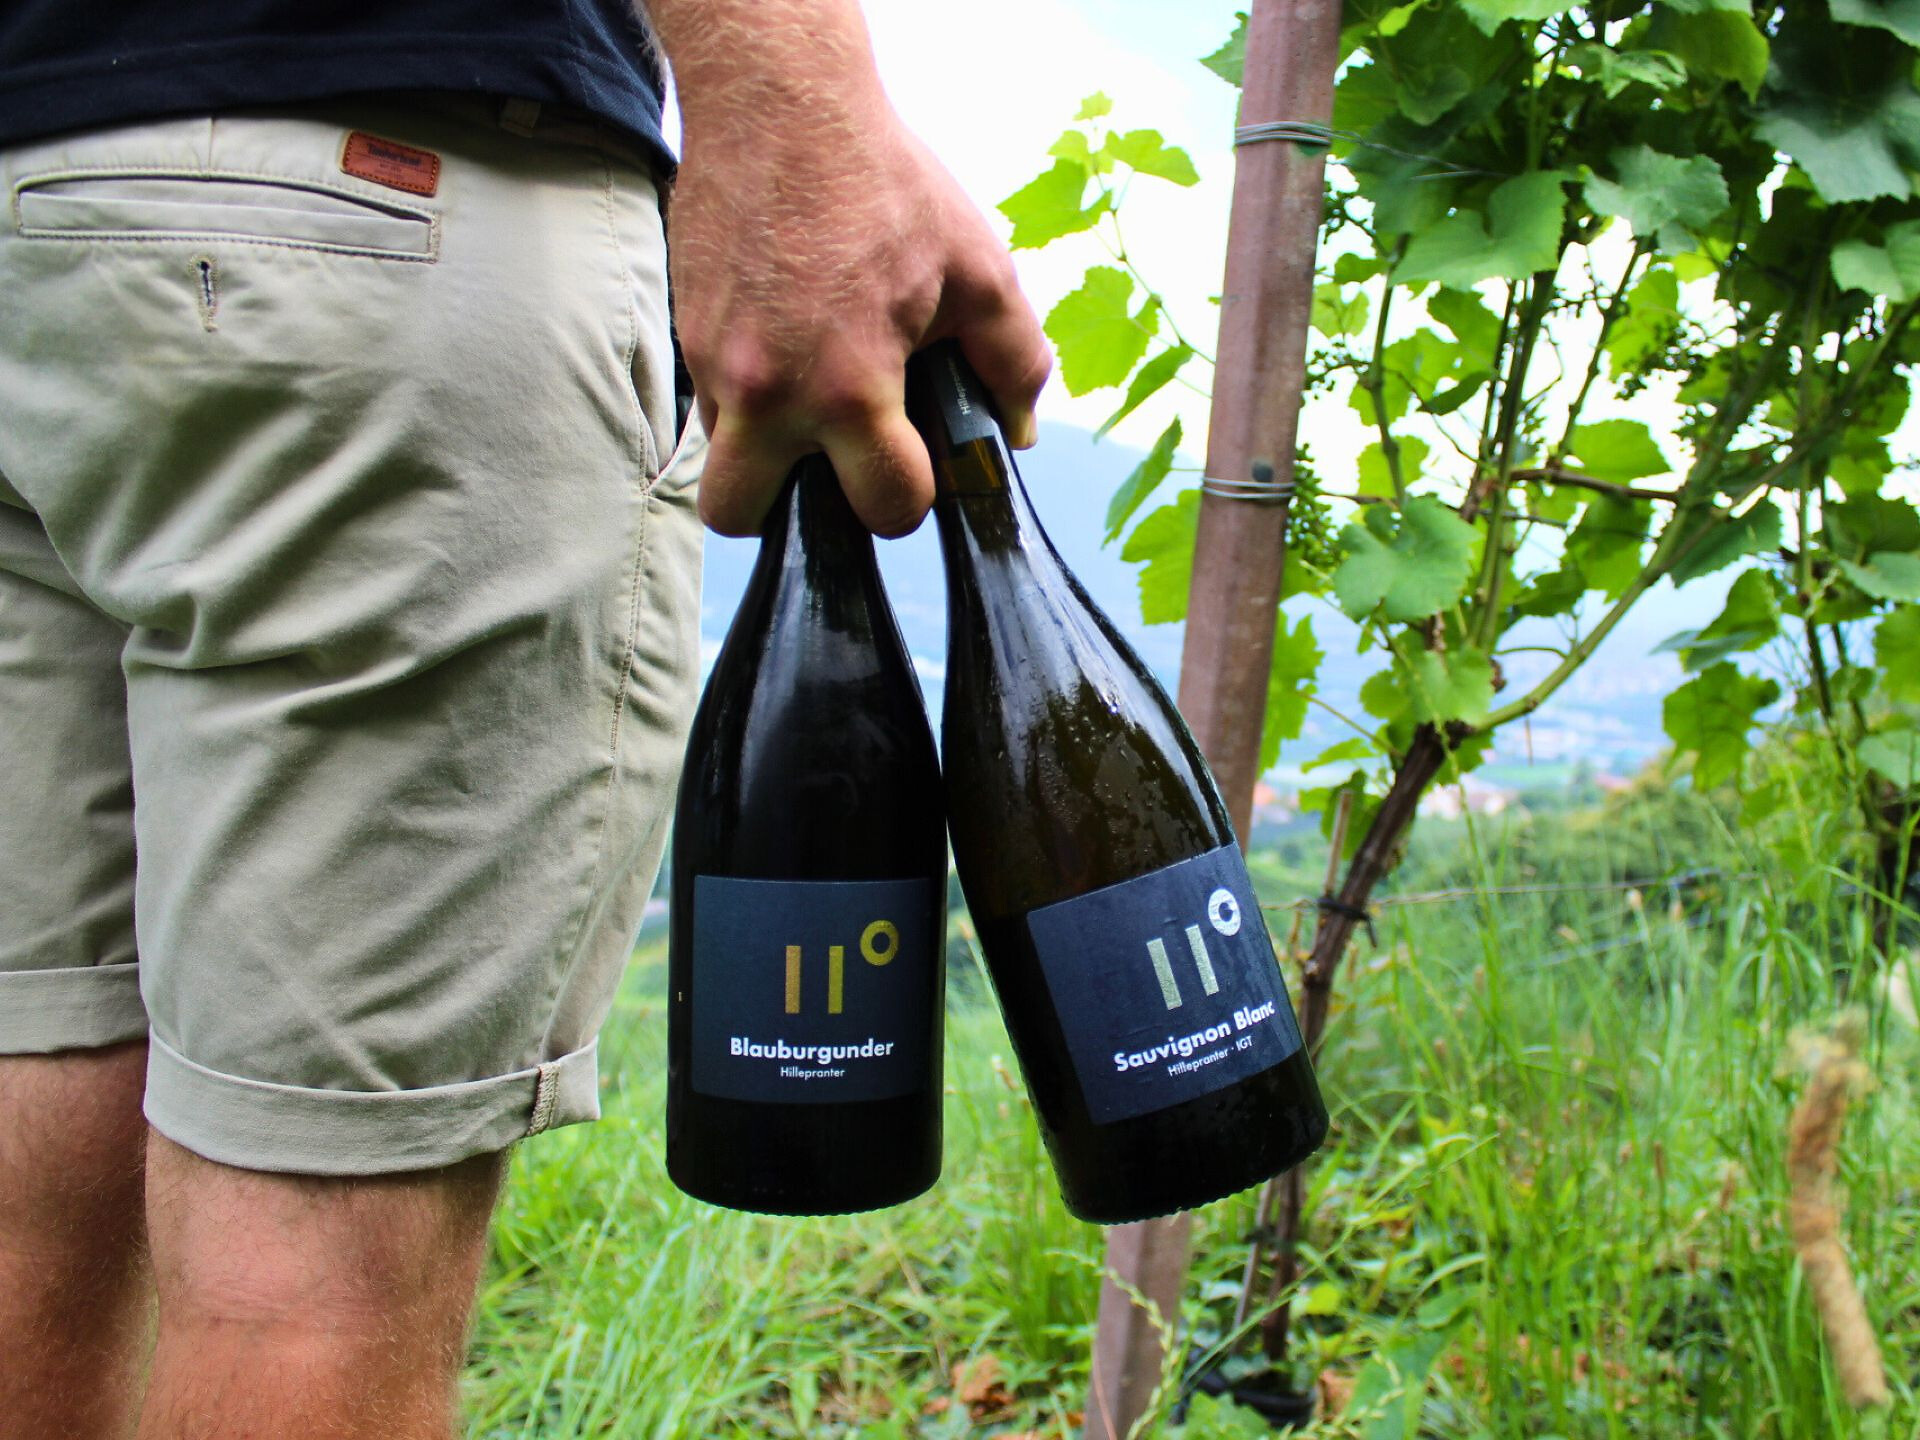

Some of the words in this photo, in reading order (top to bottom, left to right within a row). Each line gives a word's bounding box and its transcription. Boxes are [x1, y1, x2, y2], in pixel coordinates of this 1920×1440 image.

[730, 1037, 894, 1065] Blauburgunder
[1114, 1021, 1231, 1072] Sauvignon
[1233, 1001, 1275, 1030] Blanc
[1168, 1049, 1229, 1076] Hillepranter
[1235, 1036, 1253, 1052] IGT
[780, 1066, 845, 1081] Hillepranter
